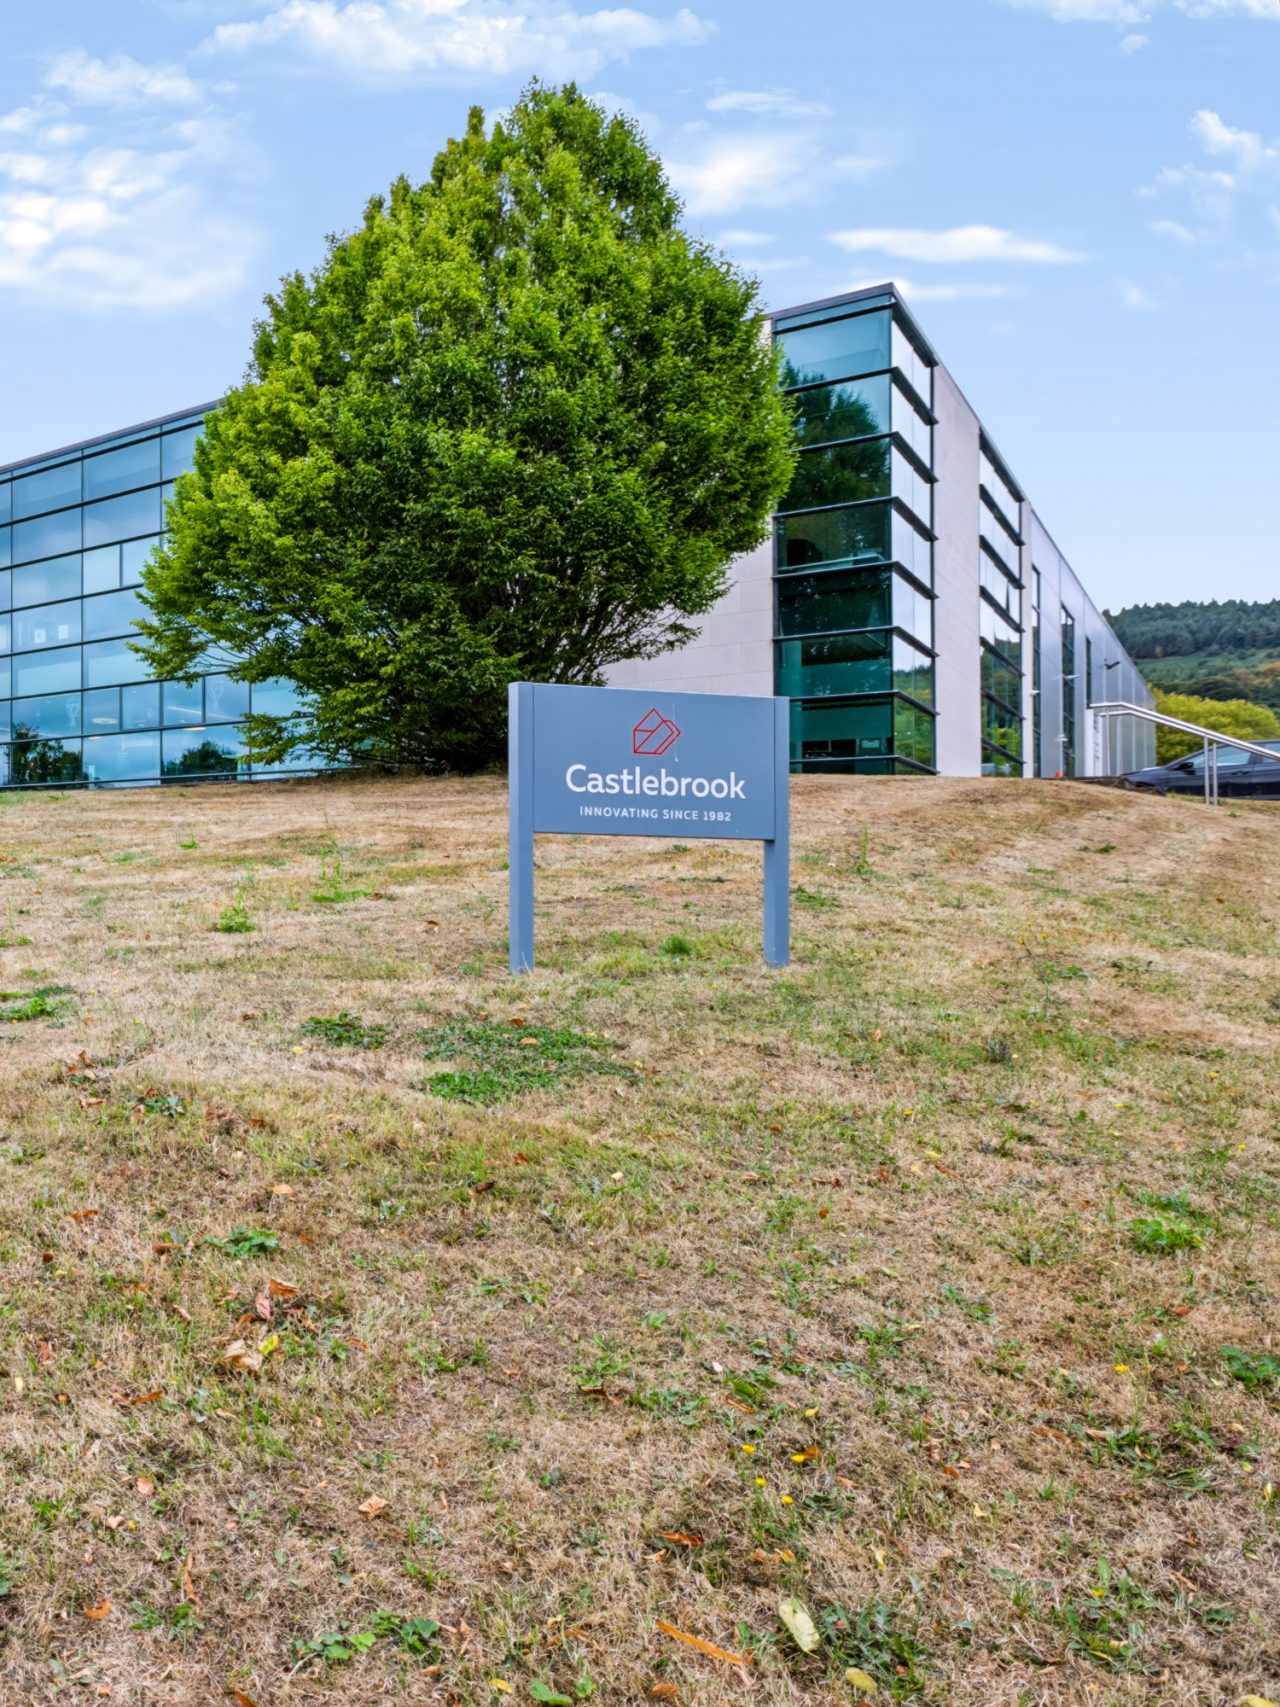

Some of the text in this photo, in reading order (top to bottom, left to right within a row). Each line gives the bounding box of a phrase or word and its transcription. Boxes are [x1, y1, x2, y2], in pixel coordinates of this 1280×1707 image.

[565, 764, 746, 799] Castlebrook
[579, 806, 732, 822] INNOVATING SINCE 1982
